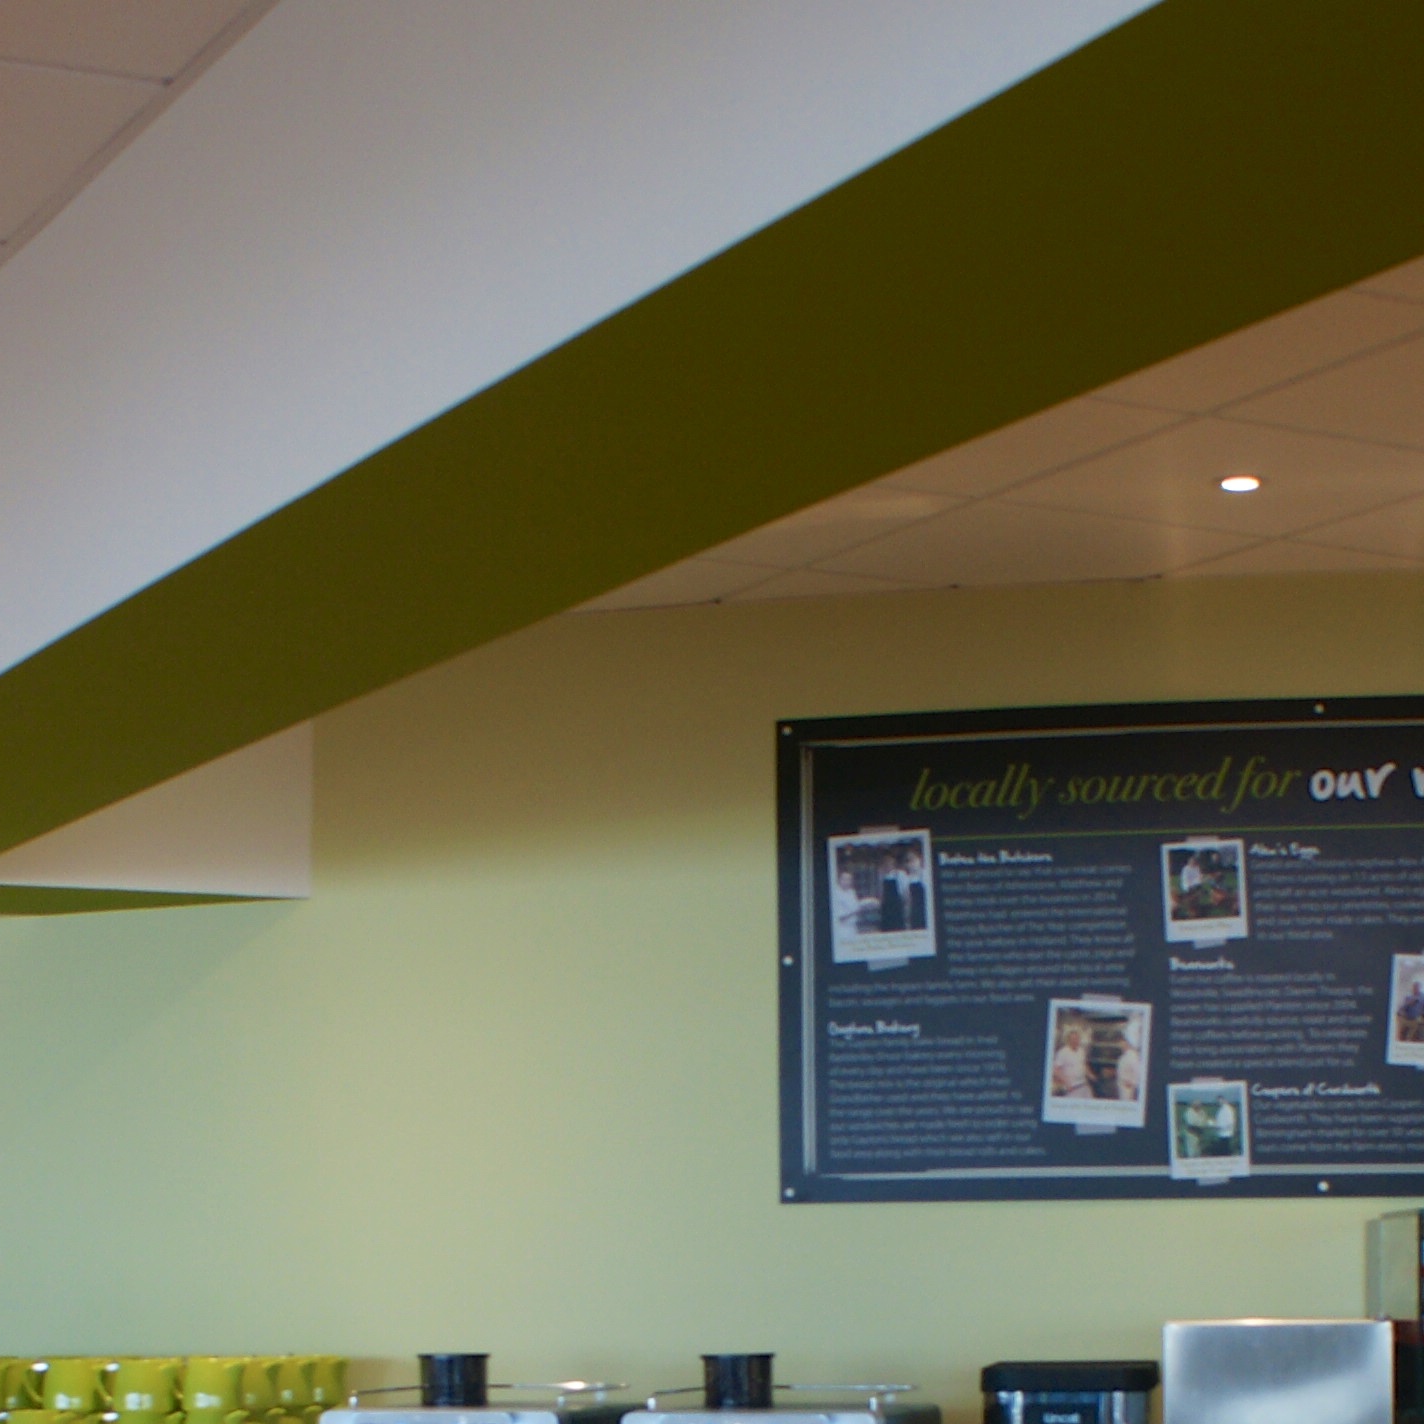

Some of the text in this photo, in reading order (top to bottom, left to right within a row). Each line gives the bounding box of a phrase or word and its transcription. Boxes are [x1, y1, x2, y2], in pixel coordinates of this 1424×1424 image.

[908, 763, 1054, 821] locally
[1059, 757, 1231, 808] sourced
[1224, 756, 1301, 815] for
[1309, 760, 1396, 800] our
